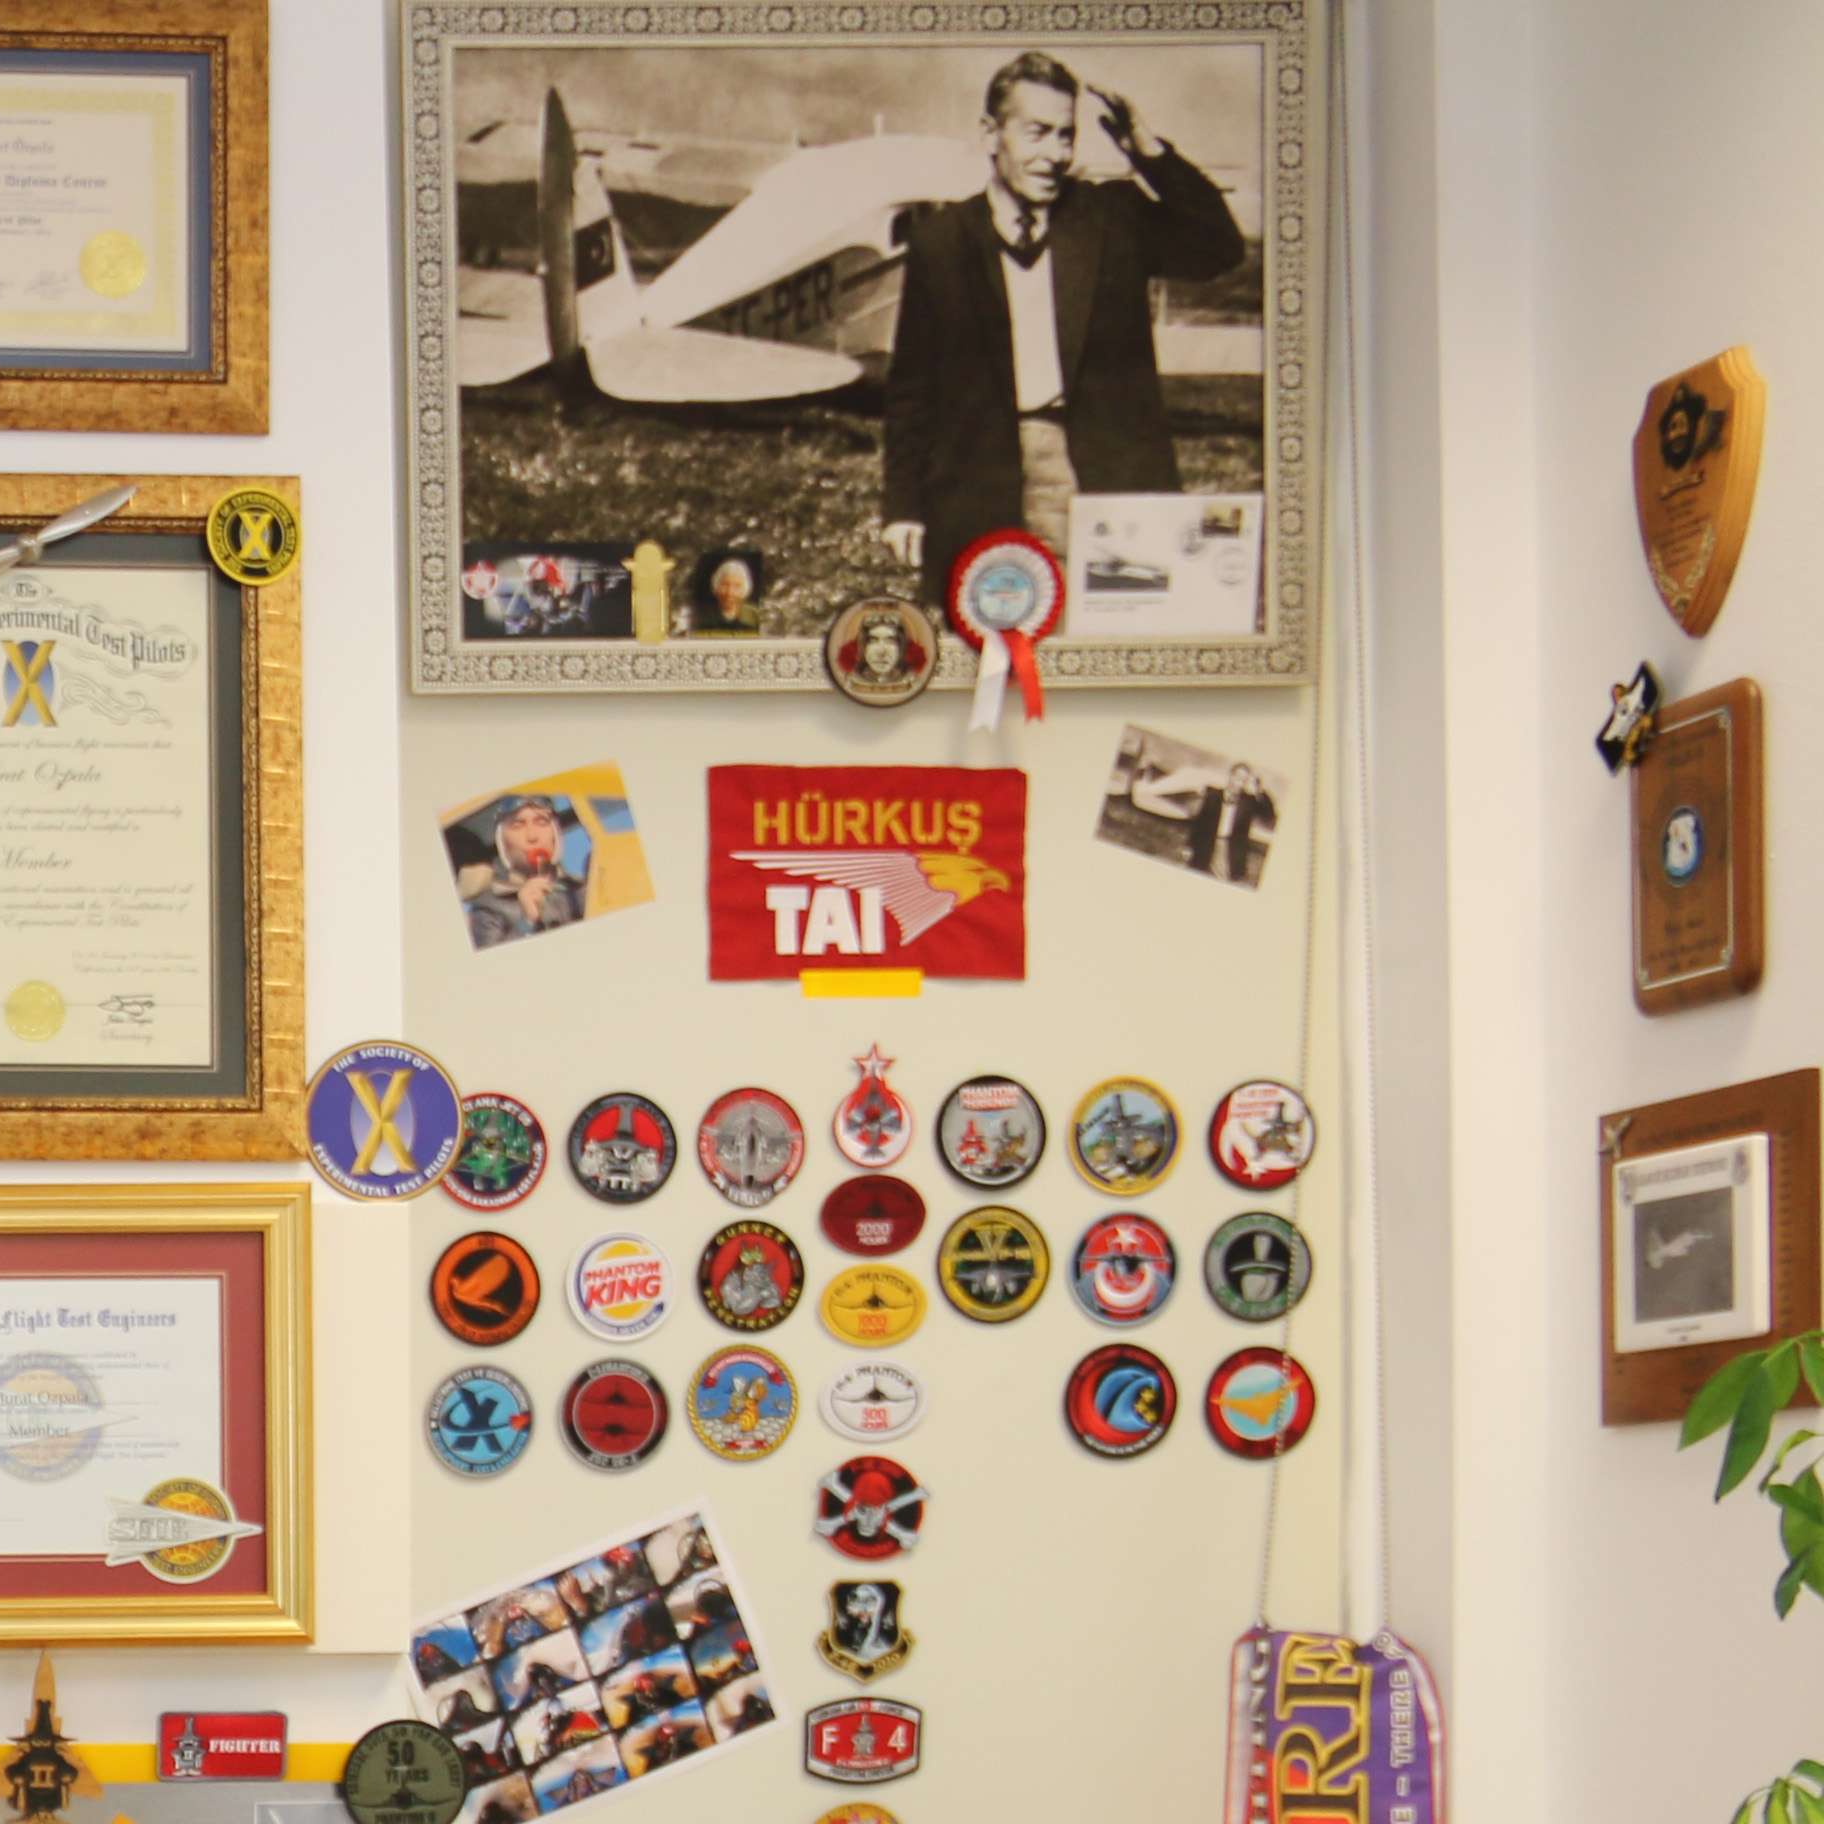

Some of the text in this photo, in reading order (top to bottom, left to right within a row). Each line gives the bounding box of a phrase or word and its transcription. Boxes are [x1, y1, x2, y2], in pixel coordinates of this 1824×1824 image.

[86, 616, 127, 655] Test
[129, 631, 188, 670] Pilots
[753, 792, 983, 855] HÜRKUŞ
[765, 885, 886, 956] TAI
[333, 1047, 430, 1074] THE SOCIETY OF
[313, 1142, 390, 1197] EXPERIMENTAL
[394, 1174, 423, 1195] TEST
[424, 1137, 454, 1180] PILOTS
[856, 1222, 892, 1237] 2000
[583, 1260, 661, 1283] PHANTOM
[583, 1275, 663, 1311] KING
[56, 1308, 92, 1329] Test
[97, 1308, 177, 1332] Engineers
[8, 1424, 70, 1440] Member
[1390, 1669, 1418, 1773] THERE
[208, 1738, 281, 1754] FIGHTER
[822, 1726, 840, 1753] F
[887, 1725, 908, 1753] 4
[387, 1741, 416, 1768] 50
